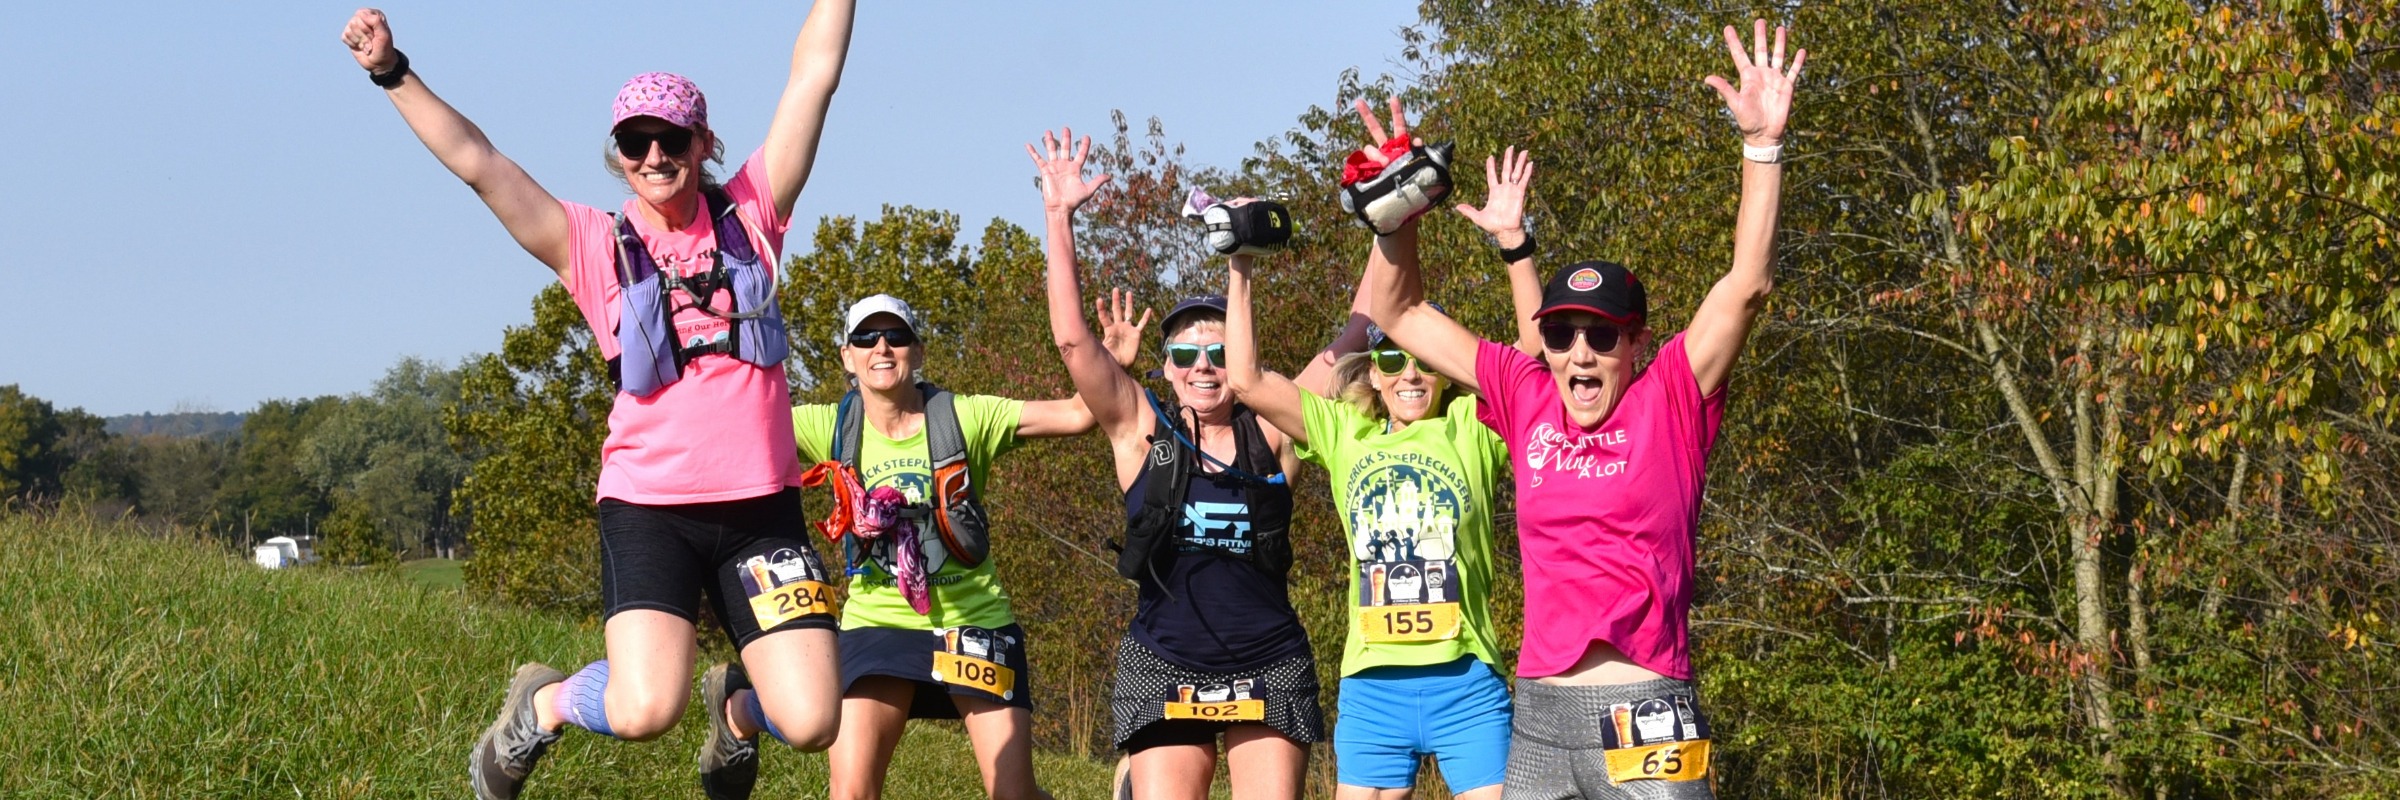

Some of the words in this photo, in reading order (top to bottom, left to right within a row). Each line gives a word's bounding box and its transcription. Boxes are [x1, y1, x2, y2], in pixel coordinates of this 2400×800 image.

[694, 323, 711, 331] Our
[1577, 429, 1628, 450] LITTLE
[883, 458, 932, 472] STEEPL
[1537, 444, 1598, 472] Wine
[1578, 466, 1590, 479] A
[1596, 460, 1628, 478] LOT
[773, 587, 829, 615] 284
[1383, 610, 1434, 635] 155
[955, 660, 997, 686] 108
[1190, 704, 1239, 717] 102
[1642, 749, 1683, 775] 65
